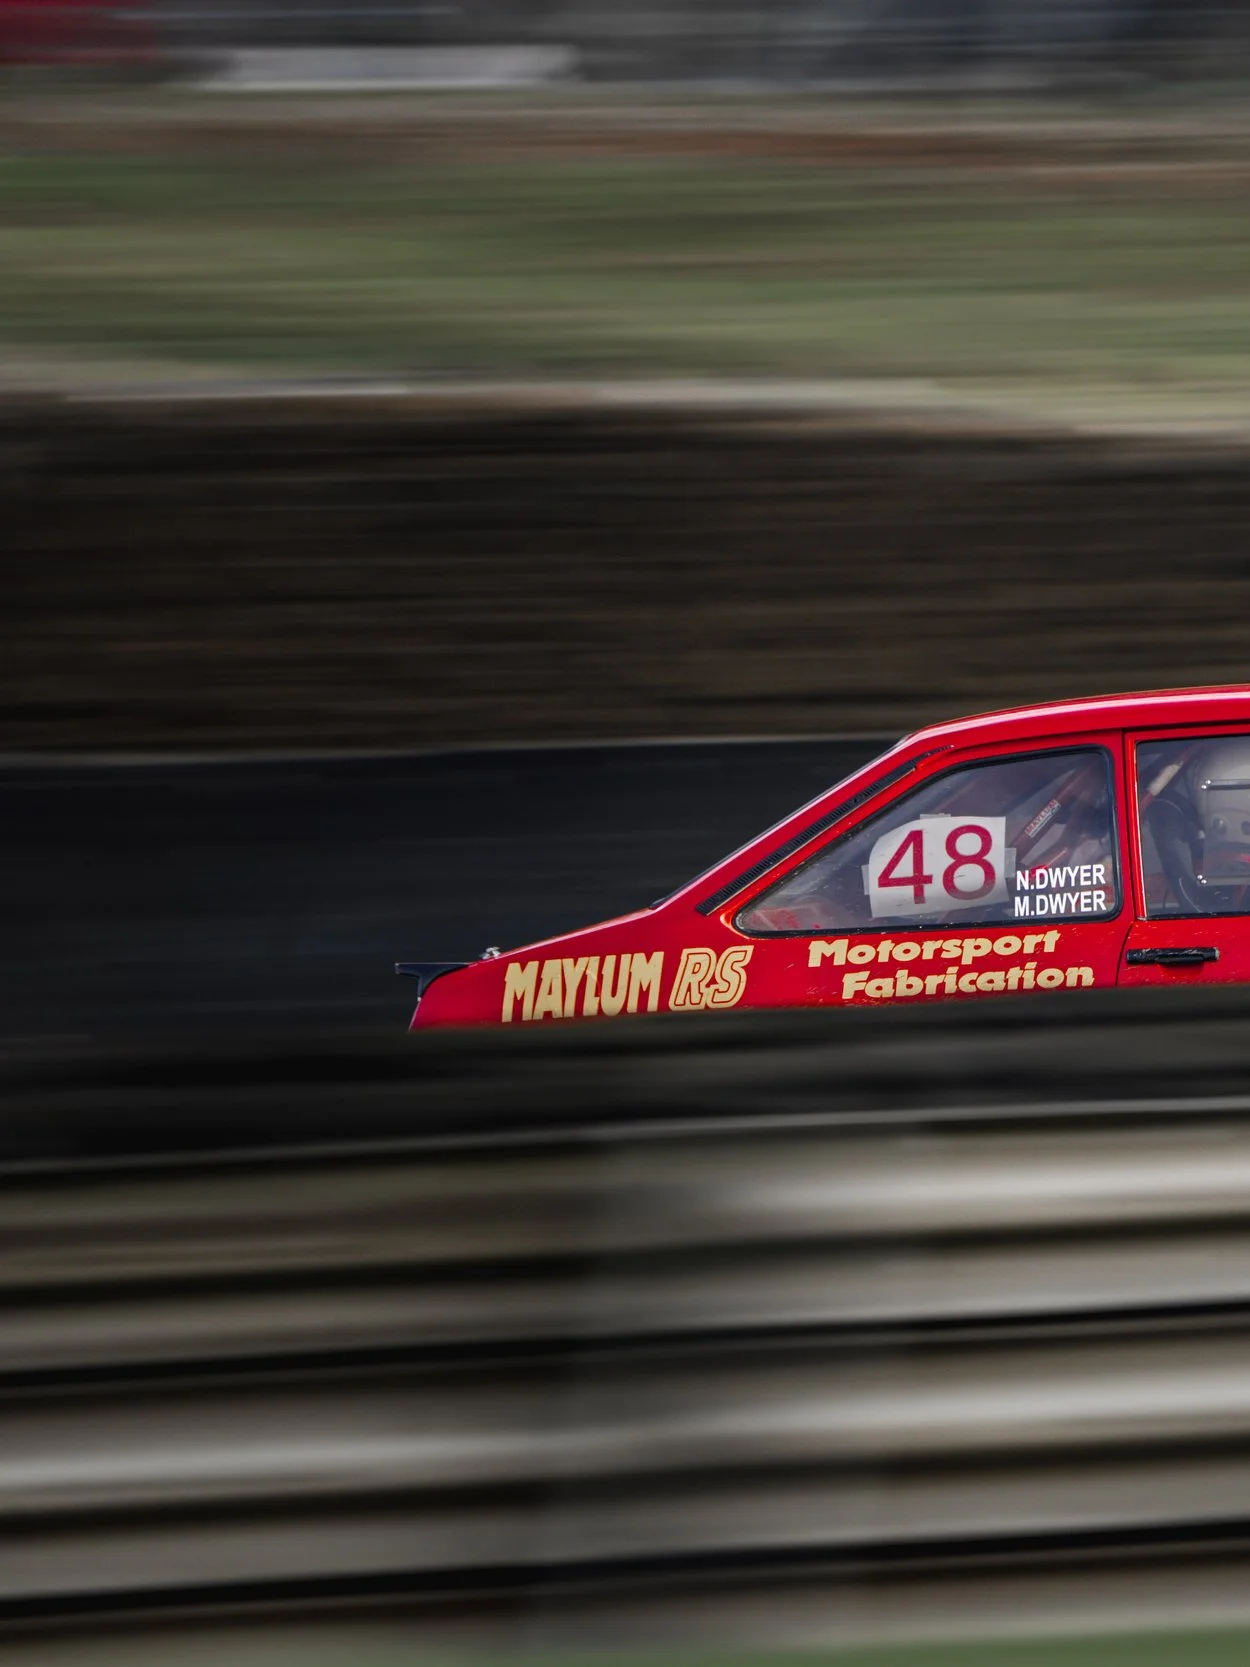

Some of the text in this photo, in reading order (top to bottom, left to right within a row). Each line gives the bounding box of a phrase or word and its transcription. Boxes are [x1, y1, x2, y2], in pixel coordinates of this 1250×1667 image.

[877, 824, 996, 904] 48
[1016, 863, 1106, 891] N.DWYER
[1014, 890, 1107, 917] M.DWYER
[808, 929, 1062, 968] Motorsport
[502, 951, 665, 1023] MAYLUM
[841, 962, 1095, 999] Fabrication
